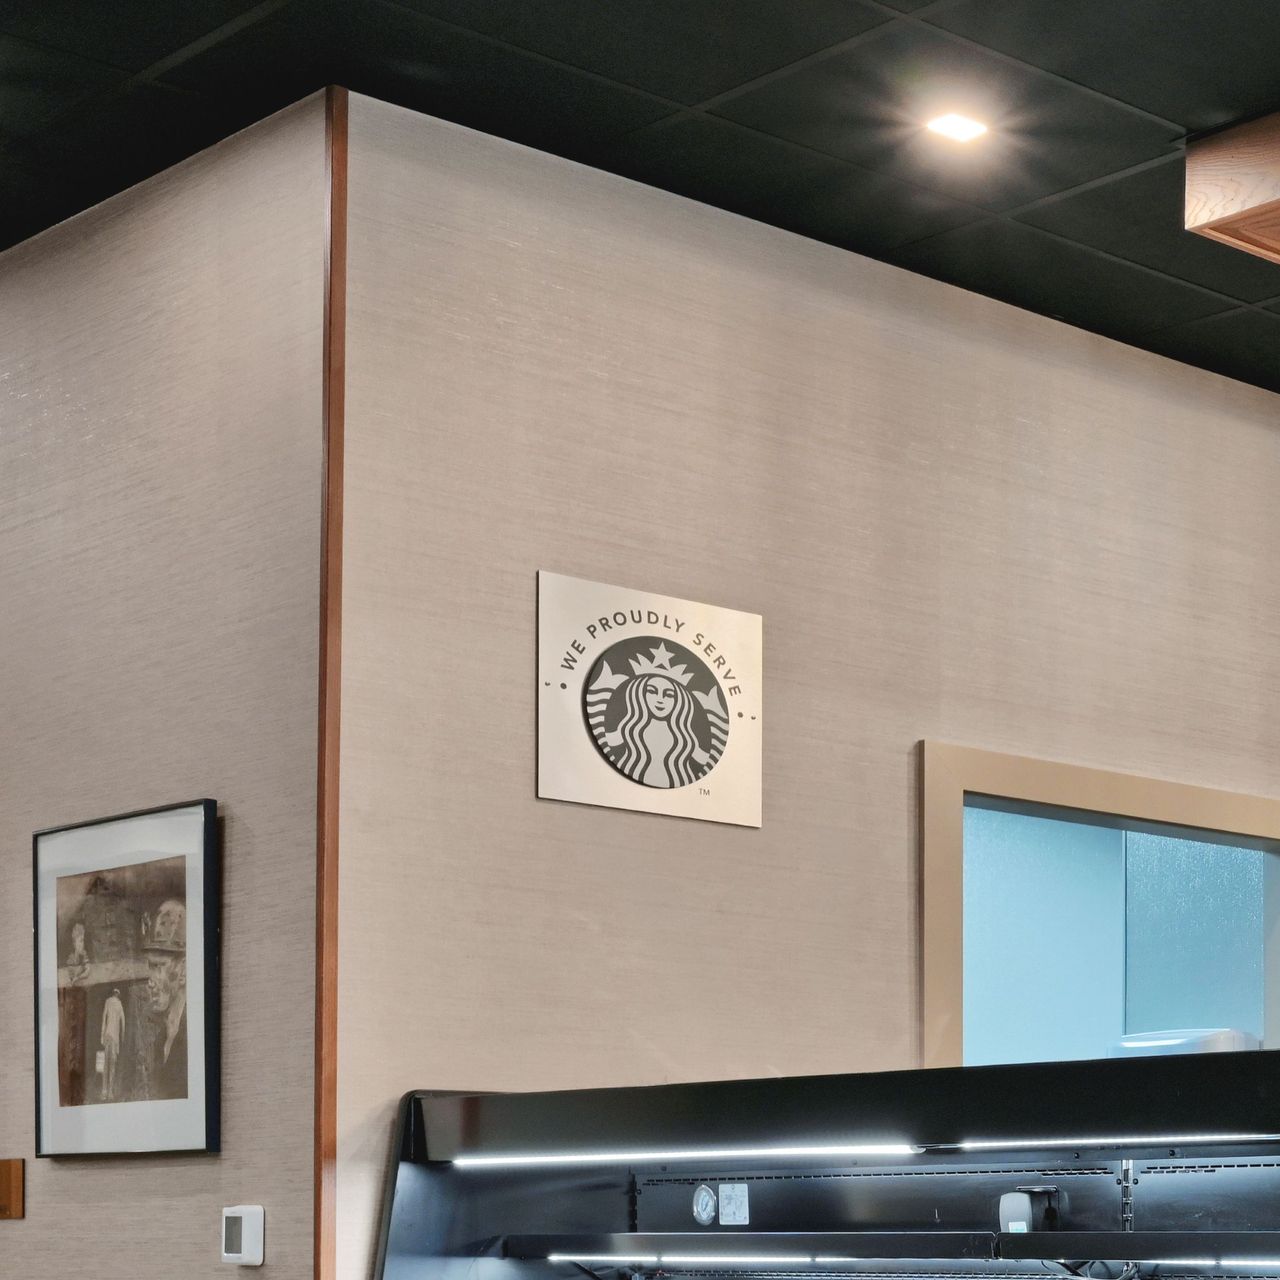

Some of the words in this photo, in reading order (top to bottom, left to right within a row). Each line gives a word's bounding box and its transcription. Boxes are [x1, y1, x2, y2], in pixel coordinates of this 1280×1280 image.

[560, 639, 586, 673] WE
[586, 609, 686, 639] PROUDLY
[692, 632, 742, 697] SERVE
